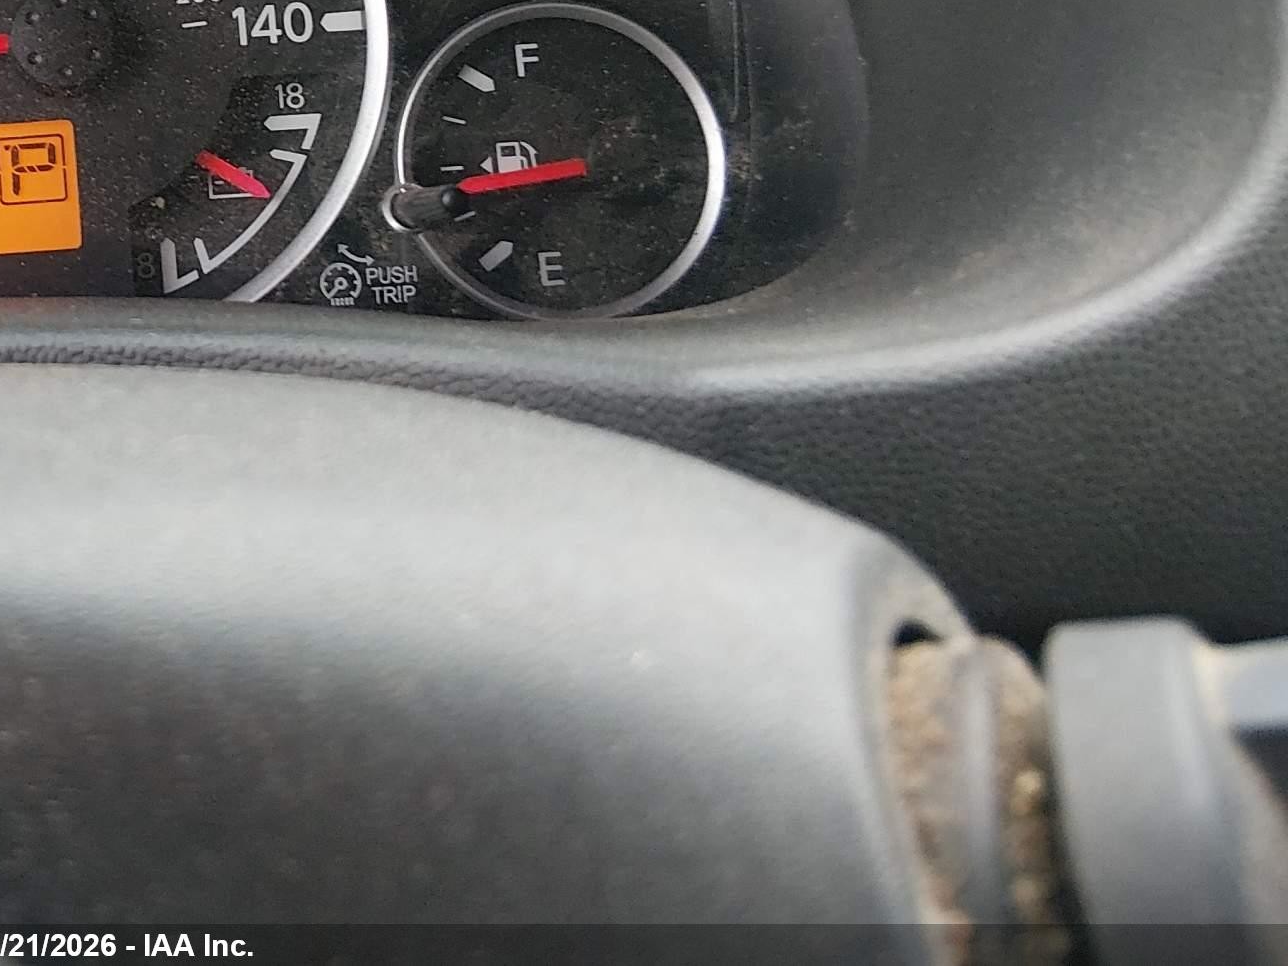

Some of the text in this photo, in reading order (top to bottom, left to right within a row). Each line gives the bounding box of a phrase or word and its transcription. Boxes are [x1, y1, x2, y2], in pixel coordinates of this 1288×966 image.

[231, 3, 313, 46] 140
[514, 43, 539, 78] F
[275, 83, 305, 109] 18
[8, 142, 57, 196] P
[366, 266, 417, 284] PUSH
[537, 252, 565, 286] E
[371, 286, 416, 303] TRIP
